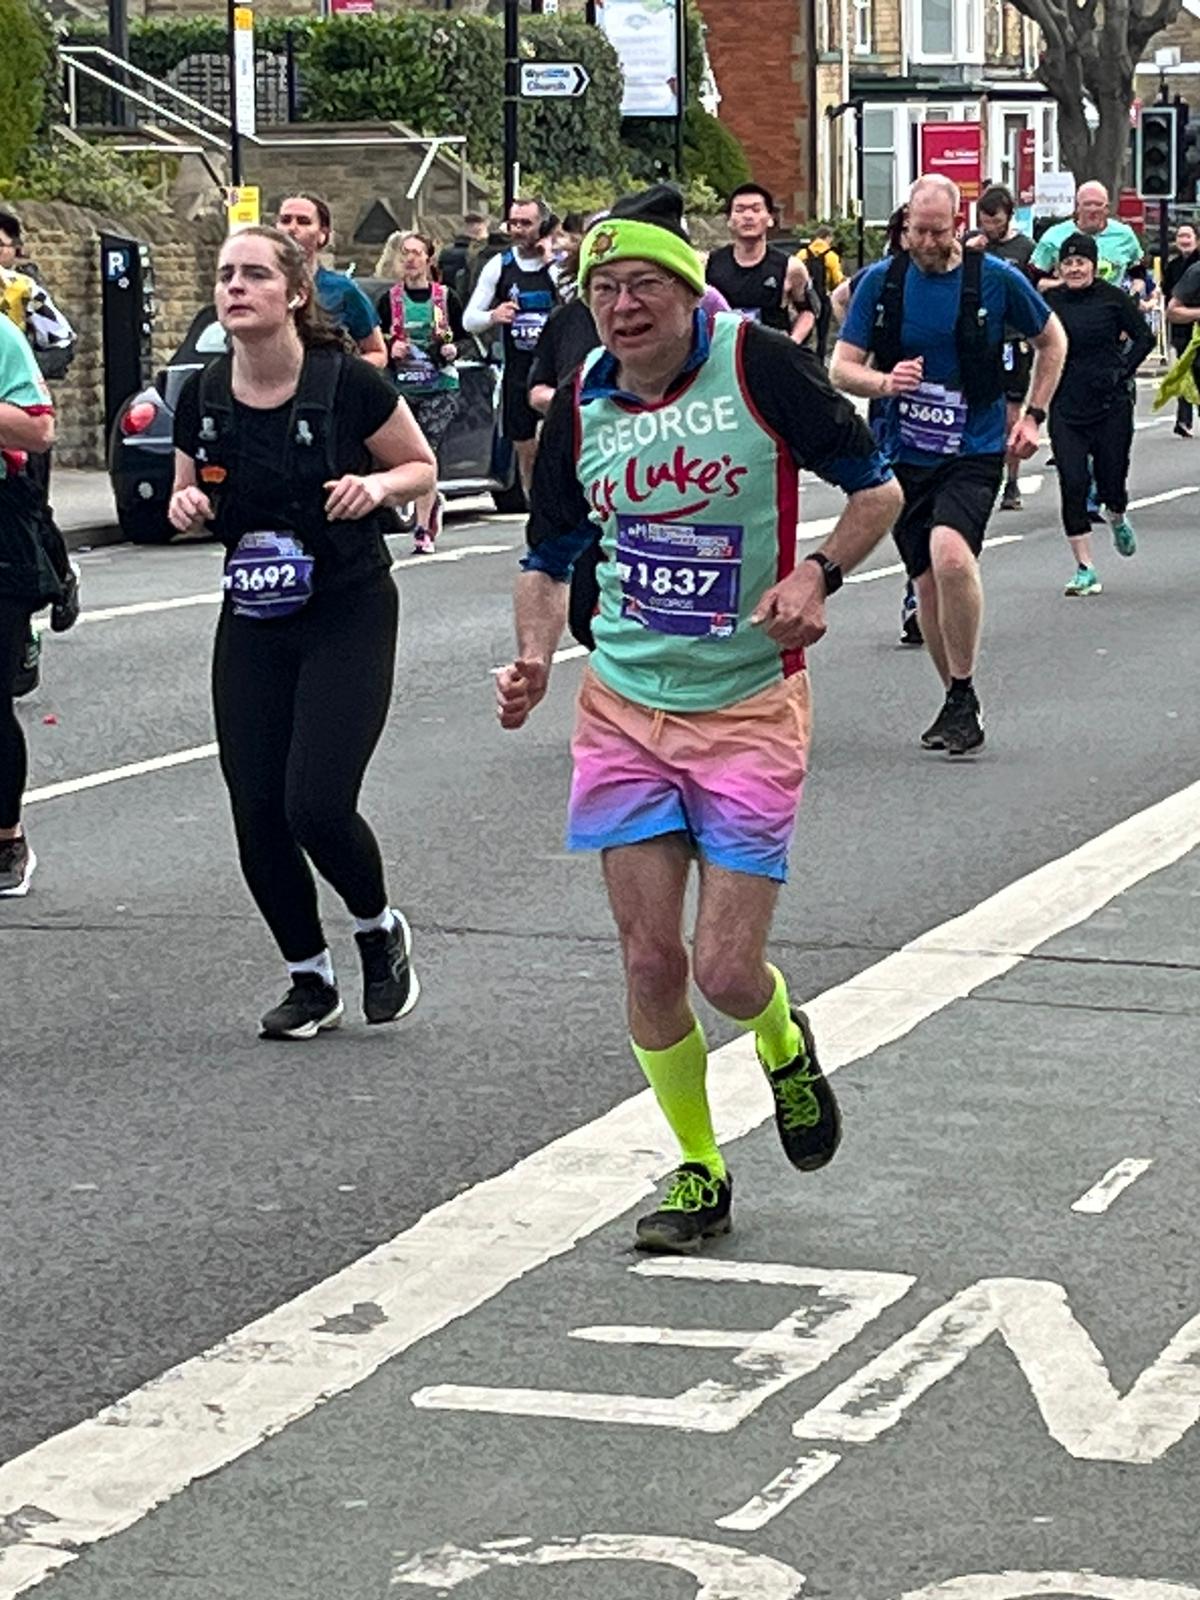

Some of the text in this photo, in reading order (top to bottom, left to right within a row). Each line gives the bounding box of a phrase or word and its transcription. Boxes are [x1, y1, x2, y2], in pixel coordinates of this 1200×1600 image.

[597, 395, 739, 458] GEORGE
[908, 403, 955, 426] 5603
[625, 446, 749, 502] Luke's
[234, 563, 296, 591] 3692
[637, 562, 720, 597] 1837
